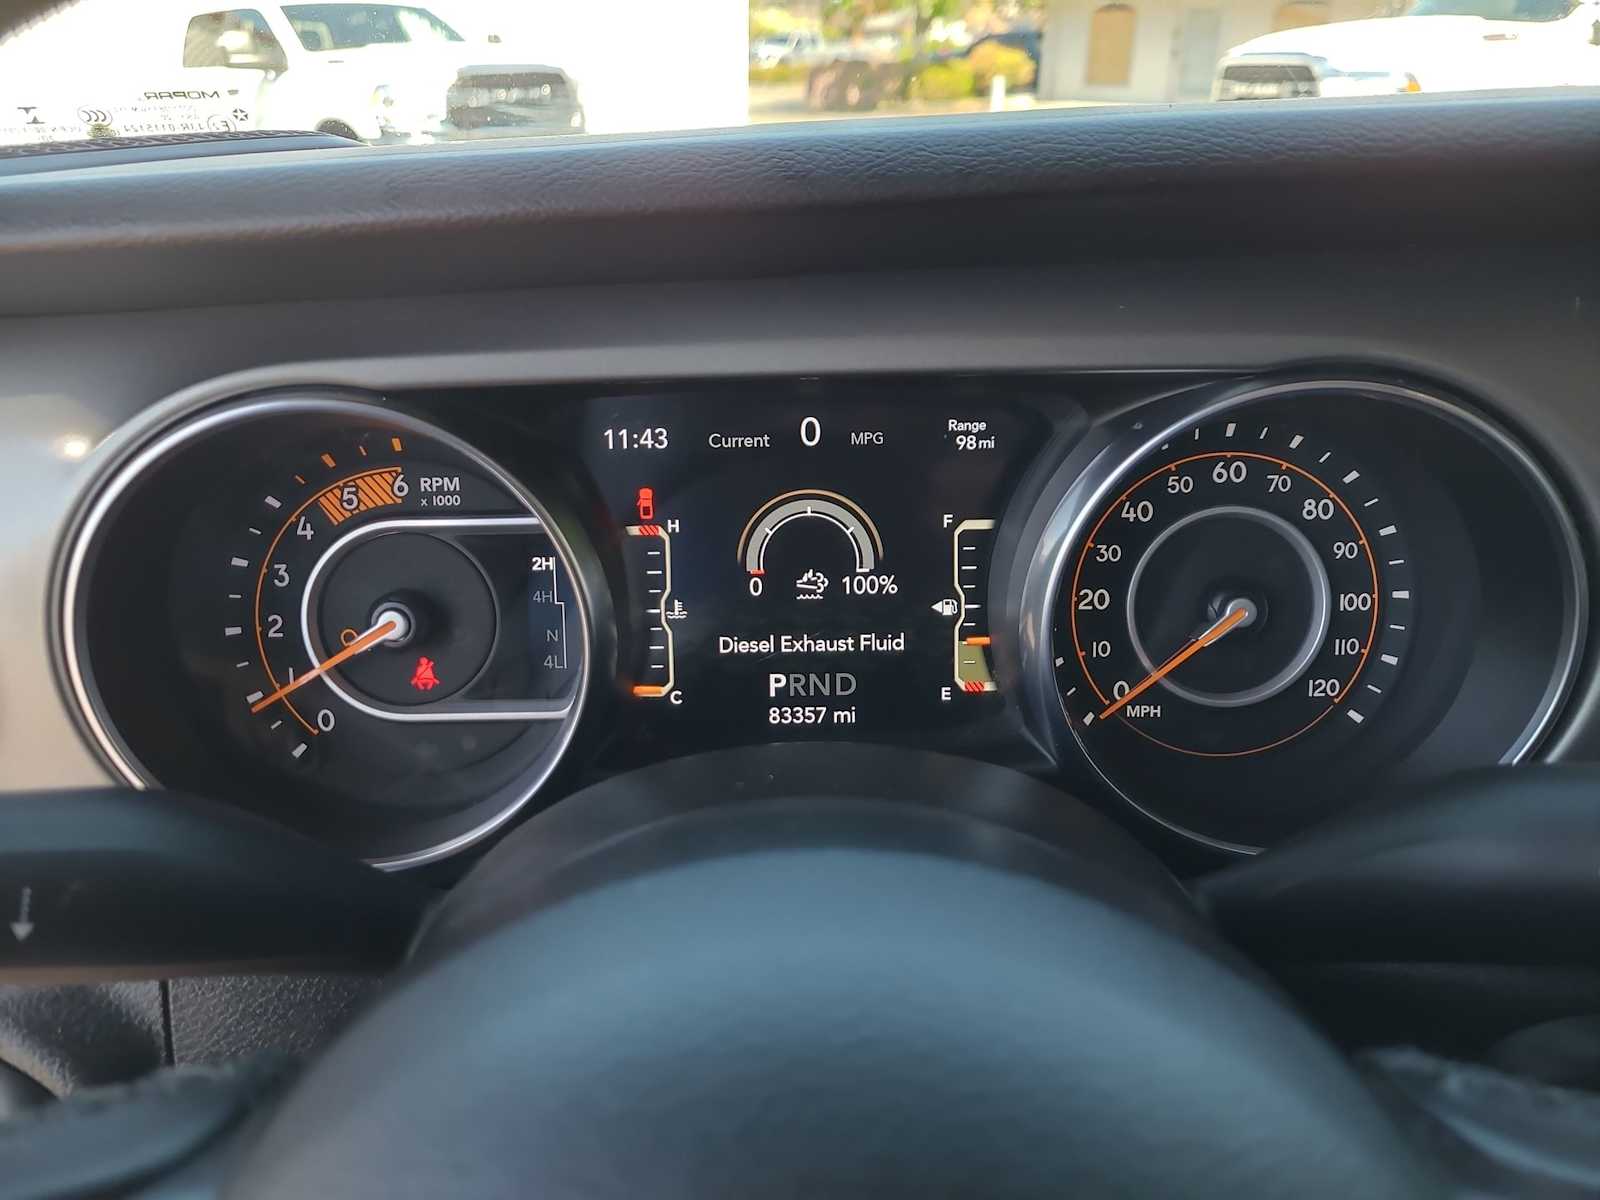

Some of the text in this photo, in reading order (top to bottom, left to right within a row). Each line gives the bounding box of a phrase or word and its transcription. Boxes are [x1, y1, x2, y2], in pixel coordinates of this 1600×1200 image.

[708, 416, 884, 448] Current 0 MPG
[947, 418, 987, 433] Range
[603, 428, 669, 450] 11:43
[955, 435, 995, 450] 98 mi
[1212, 461, 1247, 483] 60
[392, 474, 409, 498] 6
[420, 477, 460, 492] RPM
[1167, 476, 1194, 494] 50
[1266, 475, 1292, 493] 70
[342, 487, 358, 511] 5
[432, 495, 461, 507] 1000
[1121, 501, 1154, 523] 40
[1301, 499, 1335, 521] 80
[297, 516, 314, 541] 4
[667, 520, 680, 533] H
[943, 514, 953, 528] F
[1095, 544, 1122, 563] 30
[1332, 542, 1359, 560] 90
[531, 556, 554, 571] 2H
[273, 564, 291, 588] 3
[749, 577, 763, 597] 0
[841, 576, 898, 596] 100%
[532, 590, 554, 603] 4H
[1077, 589, 1110, 611] 20
[1338, 593, 1372, 612] 100
[267, 615, 285, 639] 2
[546, 629, 560, 642] N
[718, 634, 906, 655] Diesel Exhaust Fluid
[1091, 641, 1112, 658] 10
[1334, 639, 1360, 656] 110
[543, 655, 563, 669] 4L
[769, 672, 857, 698] PRND
[941, 687, 953, 701] E
[1112, 681, 1131, 701] 0
[1308, 679, 1341, 698] 120
[669, 690, 684, 706] C
[317, 709, 336, 732] 0
[768, 707, 857, 725] 83357 mi
[1126, 705, 1162, 719] MPH
